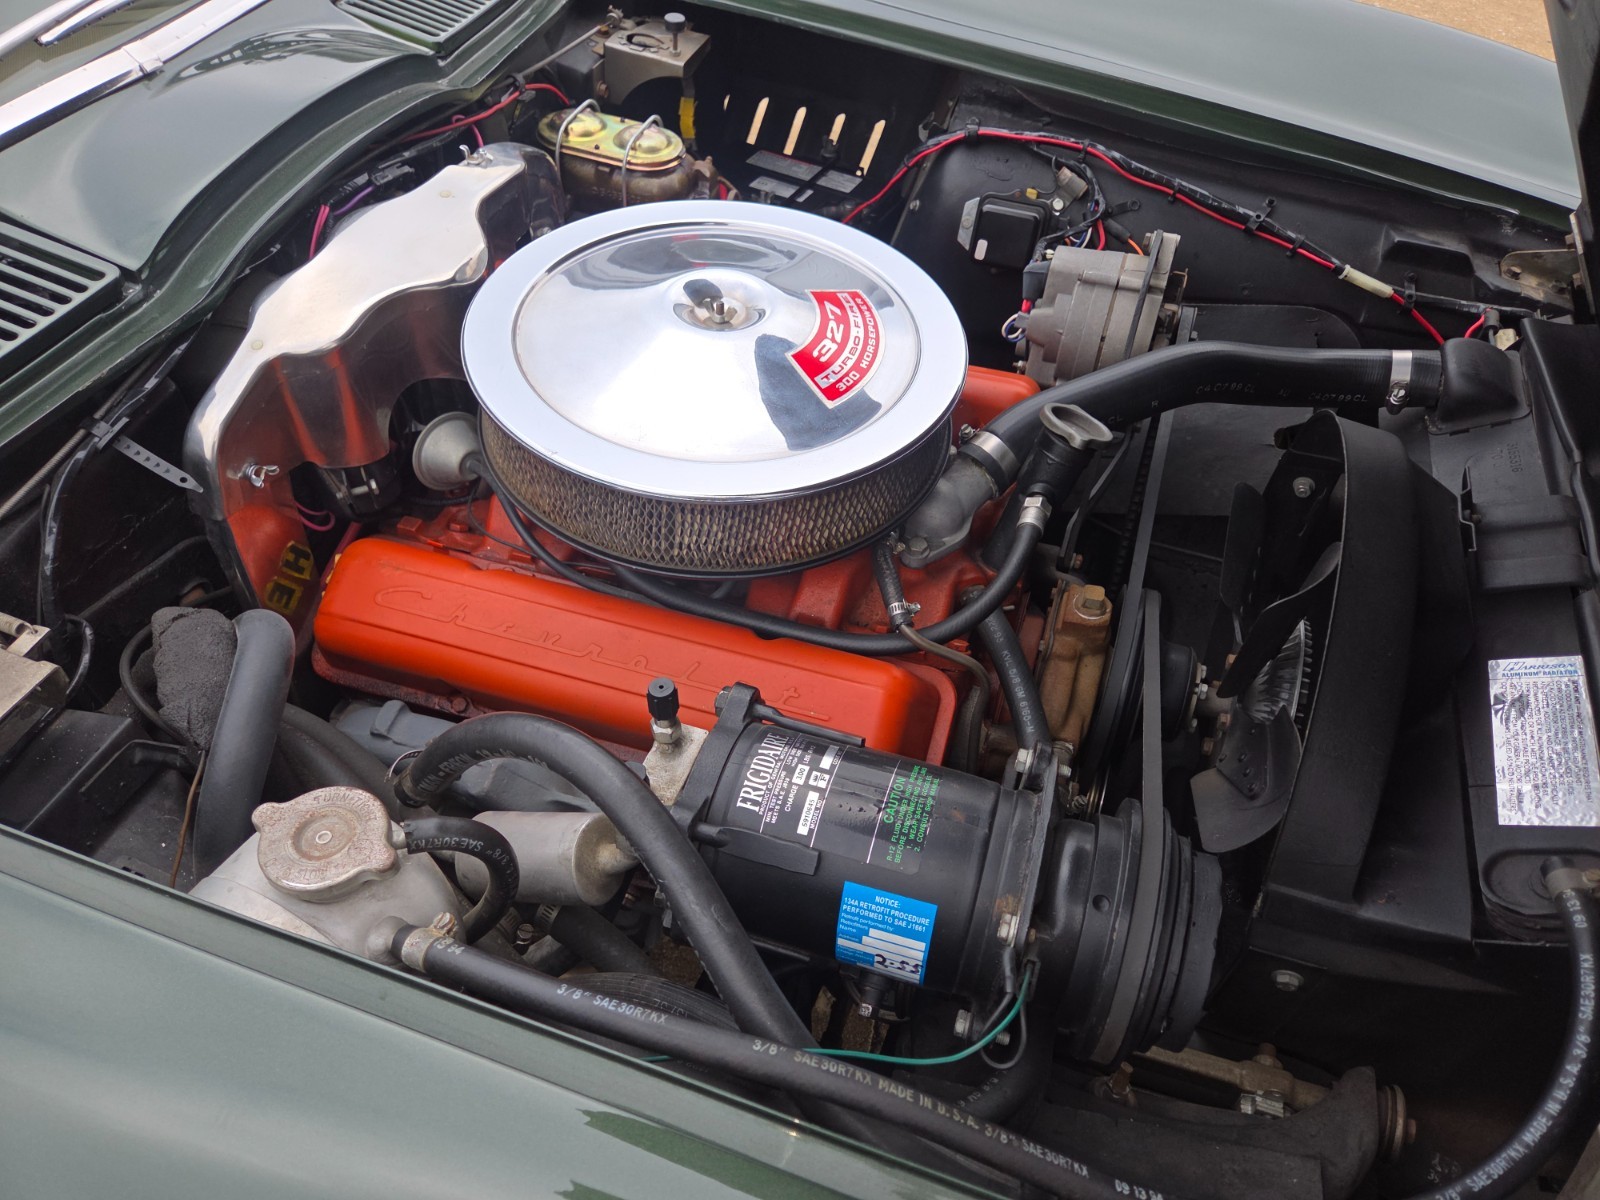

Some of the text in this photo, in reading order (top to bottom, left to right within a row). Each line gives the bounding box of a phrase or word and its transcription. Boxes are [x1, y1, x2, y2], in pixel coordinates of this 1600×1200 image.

[812, 301, 844, 362] 327
[820, 292, 861, 382] TURBO-FIRE
[836, 297, 876, 391] 300 HORSEPOWER
[373, 586, 831, 721] Chevrolt
[737, 732, 790, 813] FRIGIDAIRE
[759, 790, 770, 815] PRODUCT
[771, 761, 782, 780] GENERAL
[774, 771, 786, 795] PRESSURE
[785, 785, 799, 812] CHARGE
[810, 810, 820, 829] MODEL
[883, 777, 906, 823] CAUTION
[909, 820, 918, 839] WEAR
[915, 797, 925, 818] SAFETY
[917, 813, 929, 842] CONSULT
[925, 797, 933, 811] SHOP
[408, 837, 484, 851] SAE30R7KX
[886, 846, 895, 861] R-12
[898, 799, 908, 819] UNDER
[894, 836, 906, 863] BEFORE
[902, 786, 920, 834] DISCONNECTING
[843, 904, 883, 920] PERFORMED
[884, 915, 893, 923] TO
[894, 919, 906, 927] SAE
[845, 897, 930, 926] 134A RETROFIT PROCEDURE
[875, 896, 900, 908] NOTICE:
[557, 984, 592, 999] 3/8"
[593, 995, 668, 1024] SAE30R7KX
[1579, 953, 1596, 1021] SAE30R7KX
[1573, 1025, 1591, 1059] 3/8"
[752, 1039, 787, 1055] 3/8"
[794, 1050, 872, 1086] SAE30R7KX
[878, 1077, 914, 1102] MADE
[919, 1094, 932, 1109] IN
[984, 1124, 1015, 1144] 3/8"
[1022, 1138, 1089, 1178] SAE30R7KX
[1522, 1115, 1552, 1146] MADE
[1545, 1101, 1561, 1116] IN
[1466, 1141, 1528, 1192] SAE30R7KX
